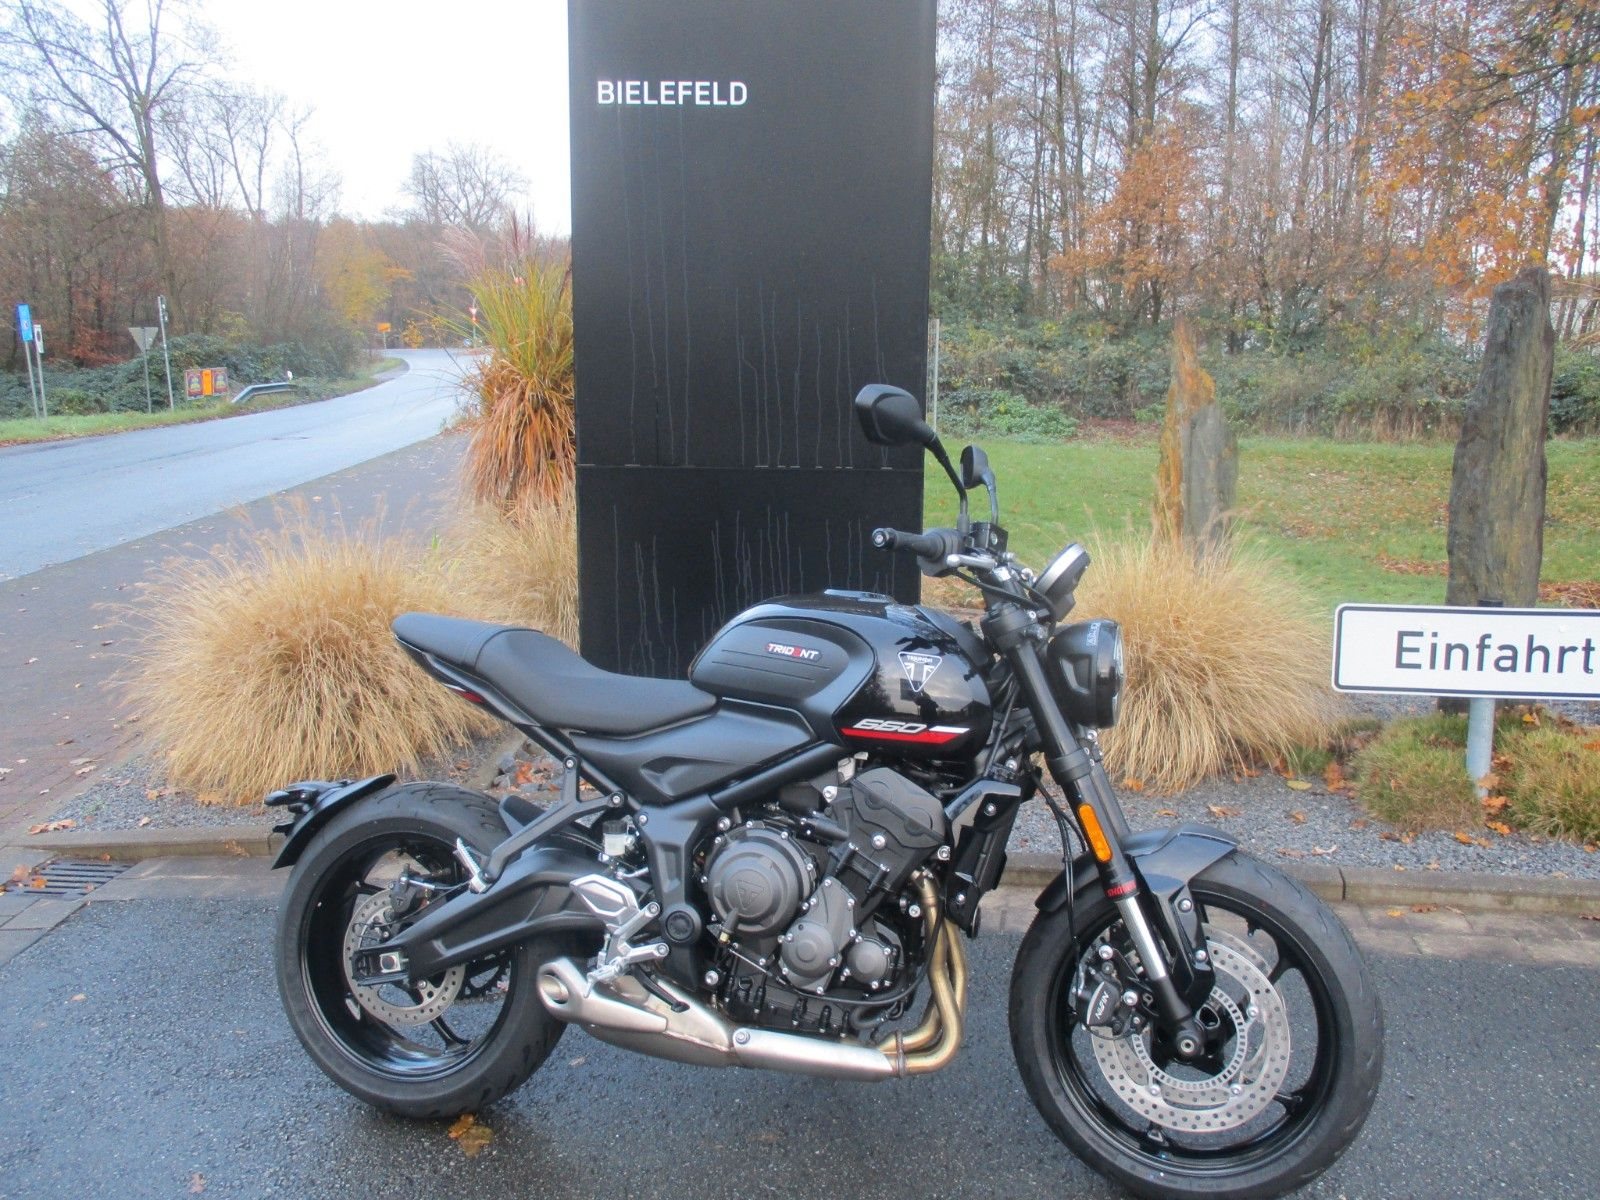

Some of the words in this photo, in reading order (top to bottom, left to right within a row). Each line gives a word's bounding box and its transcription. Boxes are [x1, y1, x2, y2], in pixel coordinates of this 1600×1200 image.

[597, 80, 748, 106] BIELEFELD
[1395, 630, 1595, 675] Einfahrt
[852, 718, 928, 734] 660
